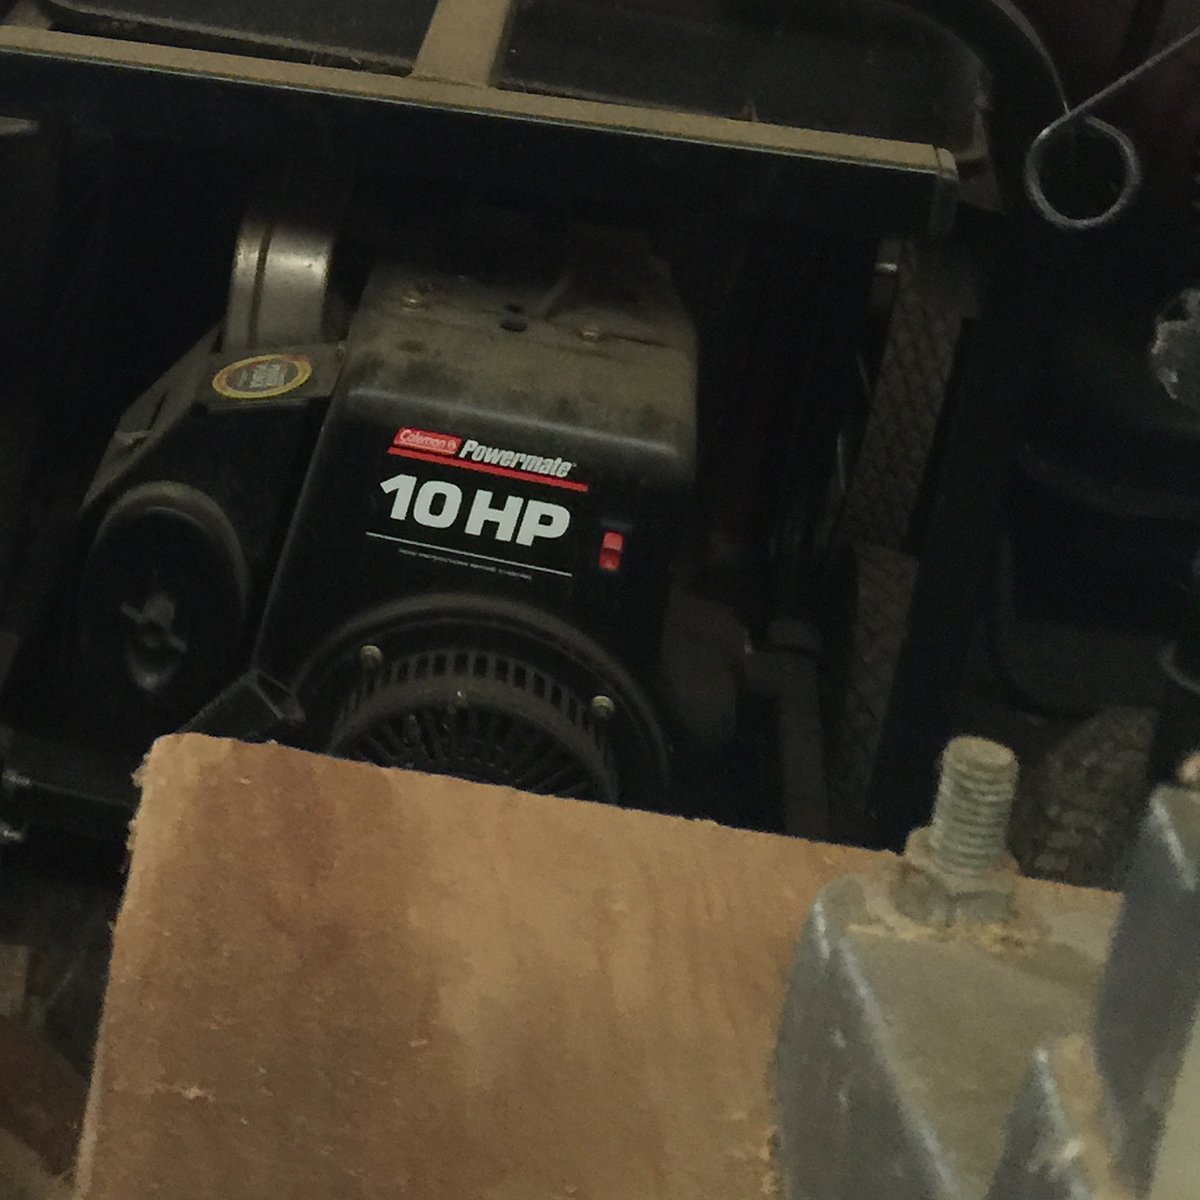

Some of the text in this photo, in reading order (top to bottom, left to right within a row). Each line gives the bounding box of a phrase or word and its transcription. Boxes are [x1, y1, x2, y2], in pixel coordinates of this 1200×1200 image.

[399, 429, 573, 478] Coleman Powermate
[380, 473, 571, 547] 10 HP
